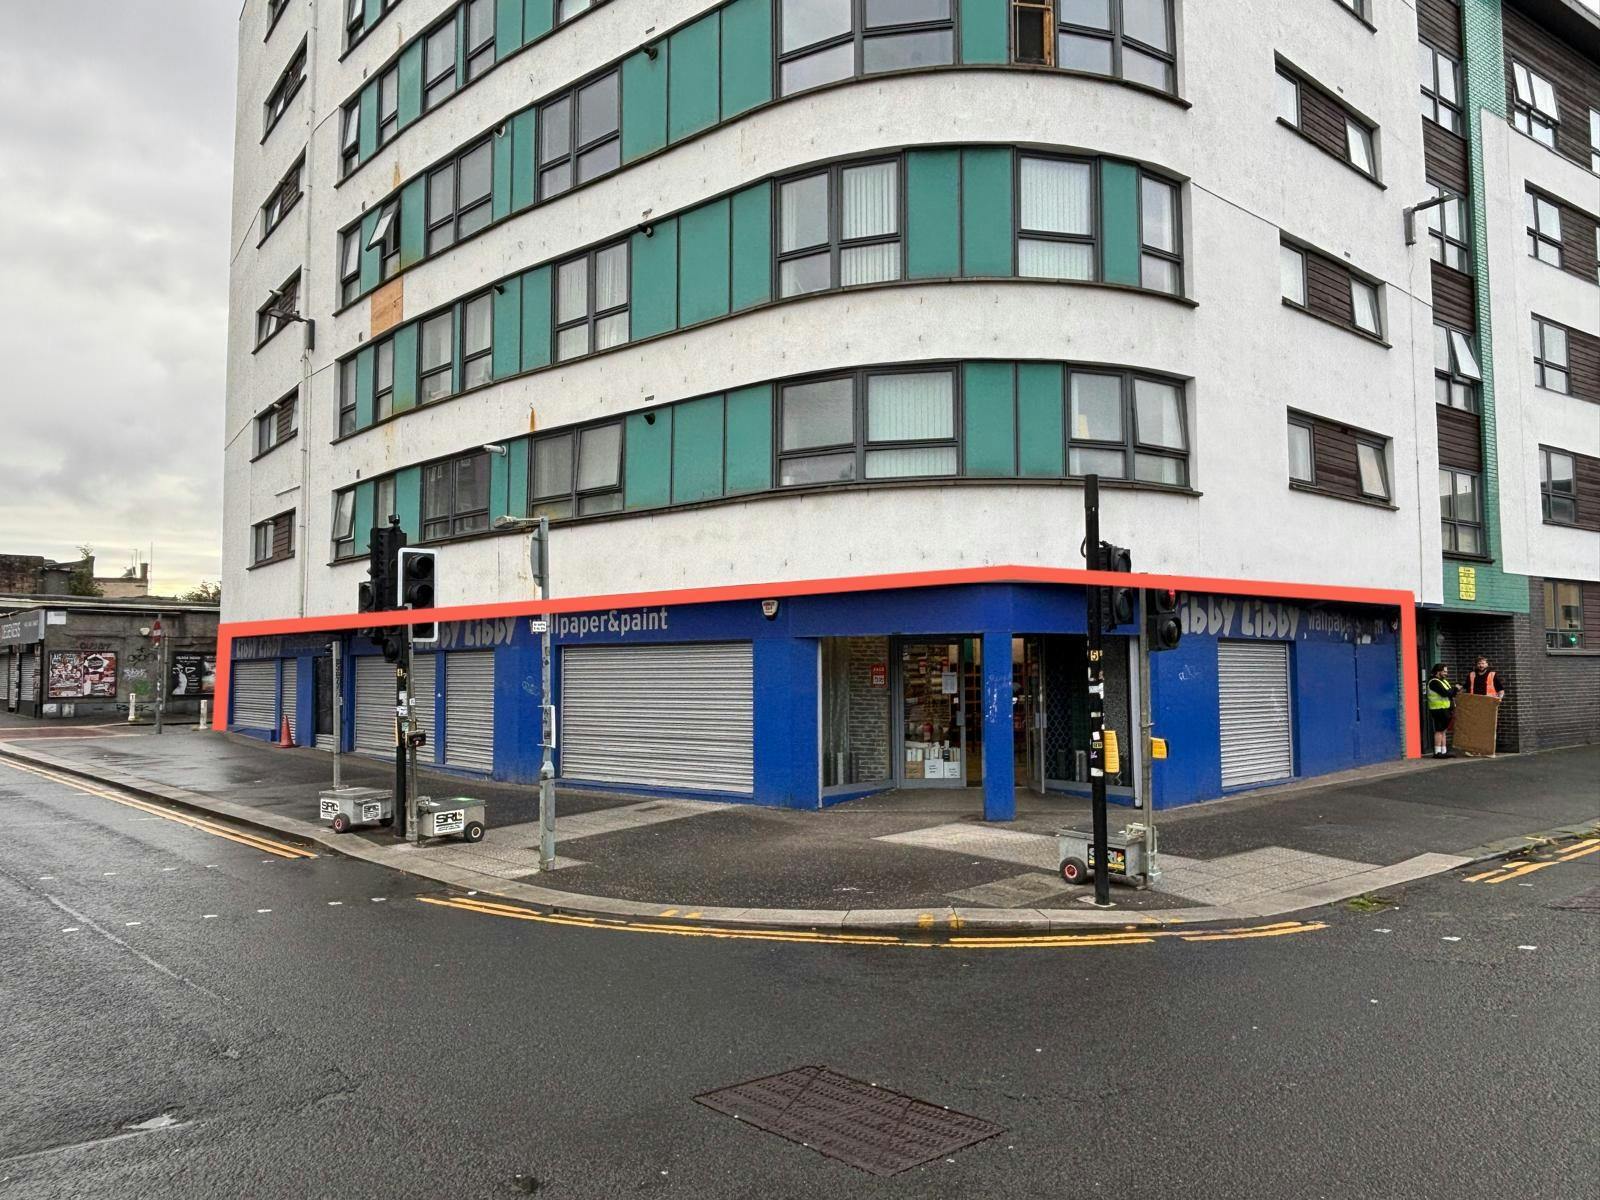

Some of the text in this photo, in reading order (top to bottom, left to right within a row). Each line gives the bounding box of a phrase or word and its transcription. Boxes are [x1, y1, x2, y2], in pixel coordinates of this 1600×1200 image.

[1178, 592, 1235, 637] ibby
[1241, 601, 1299, 640] Libby
[435, 812, 463, 824] SRL
